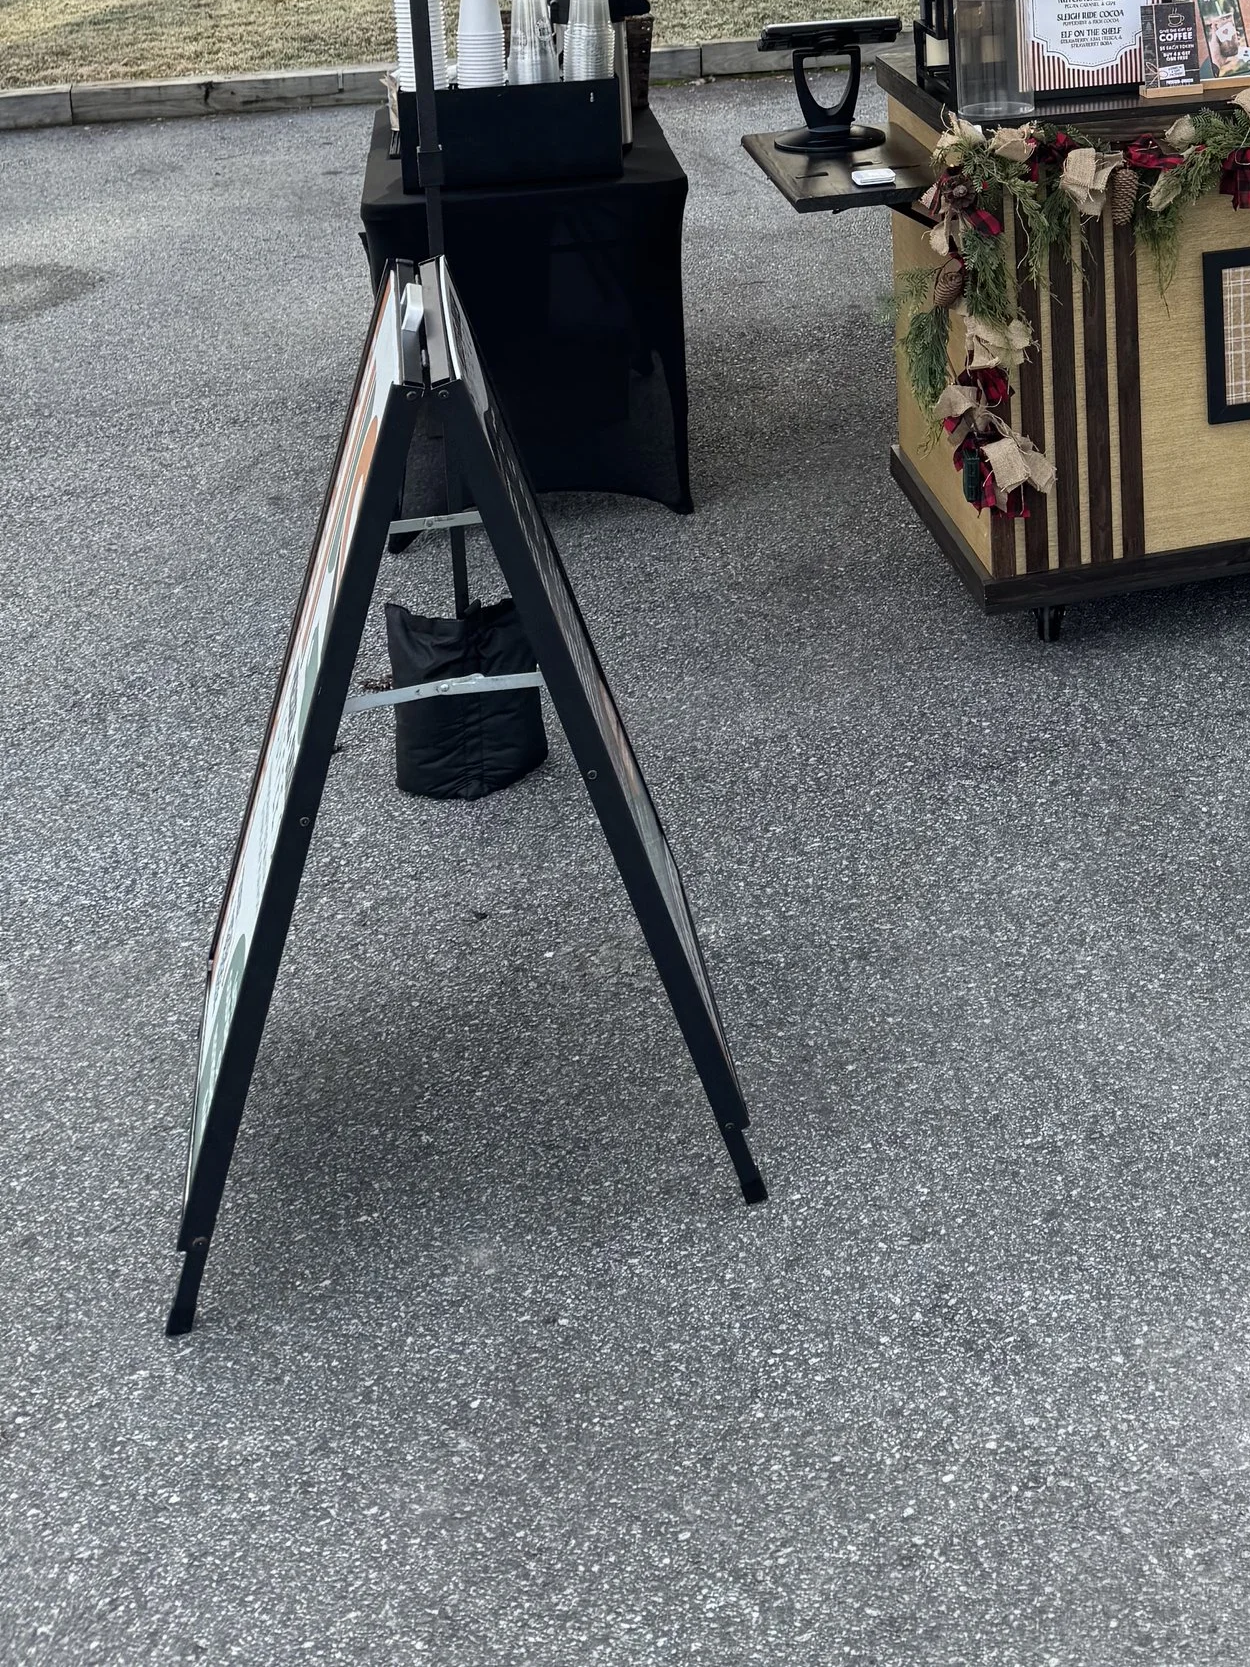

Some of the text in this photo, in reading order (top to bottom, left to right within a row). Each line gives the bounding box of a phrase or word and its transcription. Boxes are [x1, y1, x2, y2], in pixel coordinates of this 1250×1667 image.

[1057, 9, 1124, 21] SLEIGH RIDE COCOA
[1074, 29, 1085, 37] ON
[1087, 28, 1100, 36] THE
[1101, 27, 1122, 35] SHELF
[1159, 32, 1193, 42] COFFEE
